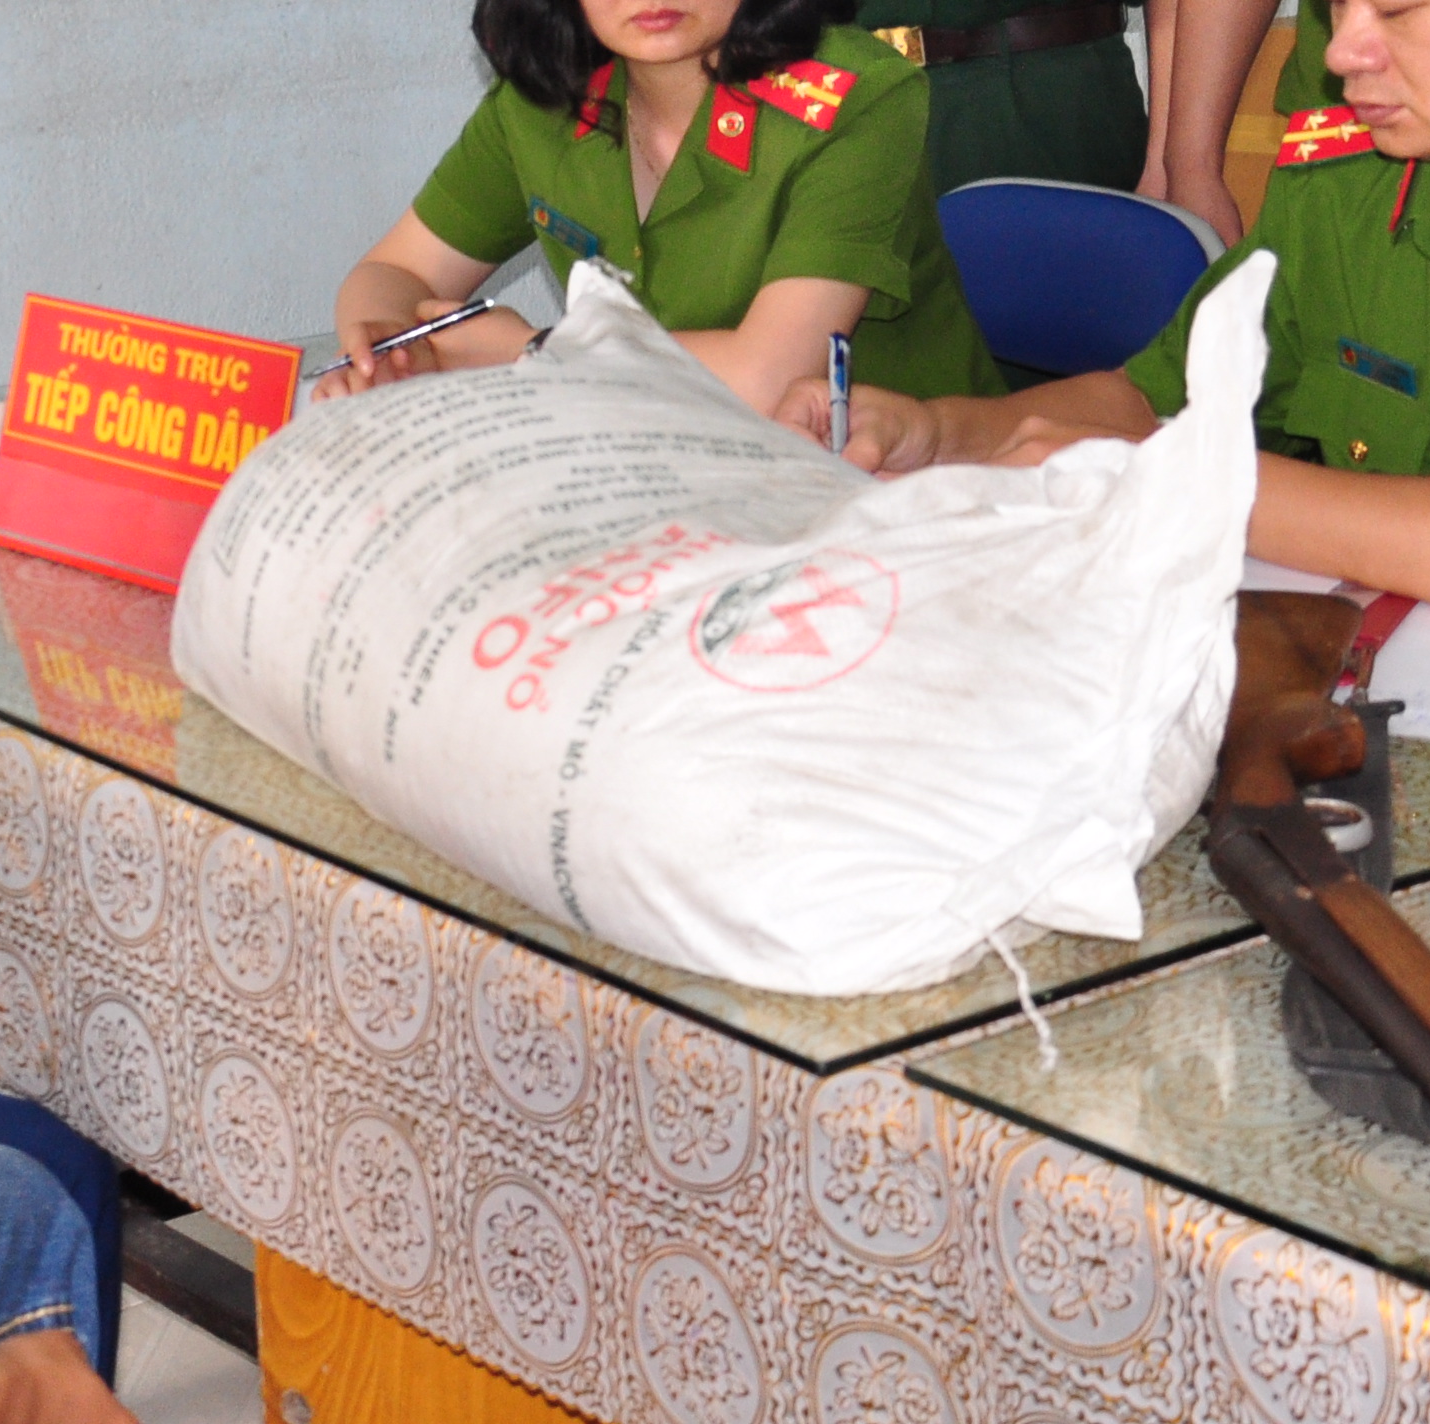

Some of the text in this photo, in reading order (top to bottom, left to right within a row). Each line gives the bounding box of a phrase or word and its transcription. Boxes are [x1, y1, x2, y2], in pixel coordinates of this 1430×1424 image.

[59, 322, 253, 396] THƯỜNG TRỰC
[23, 363, 90, 434] TIẾP
[94, 387, 187, 462] CÔNG
[505, 636, 571, 713] NỔ
